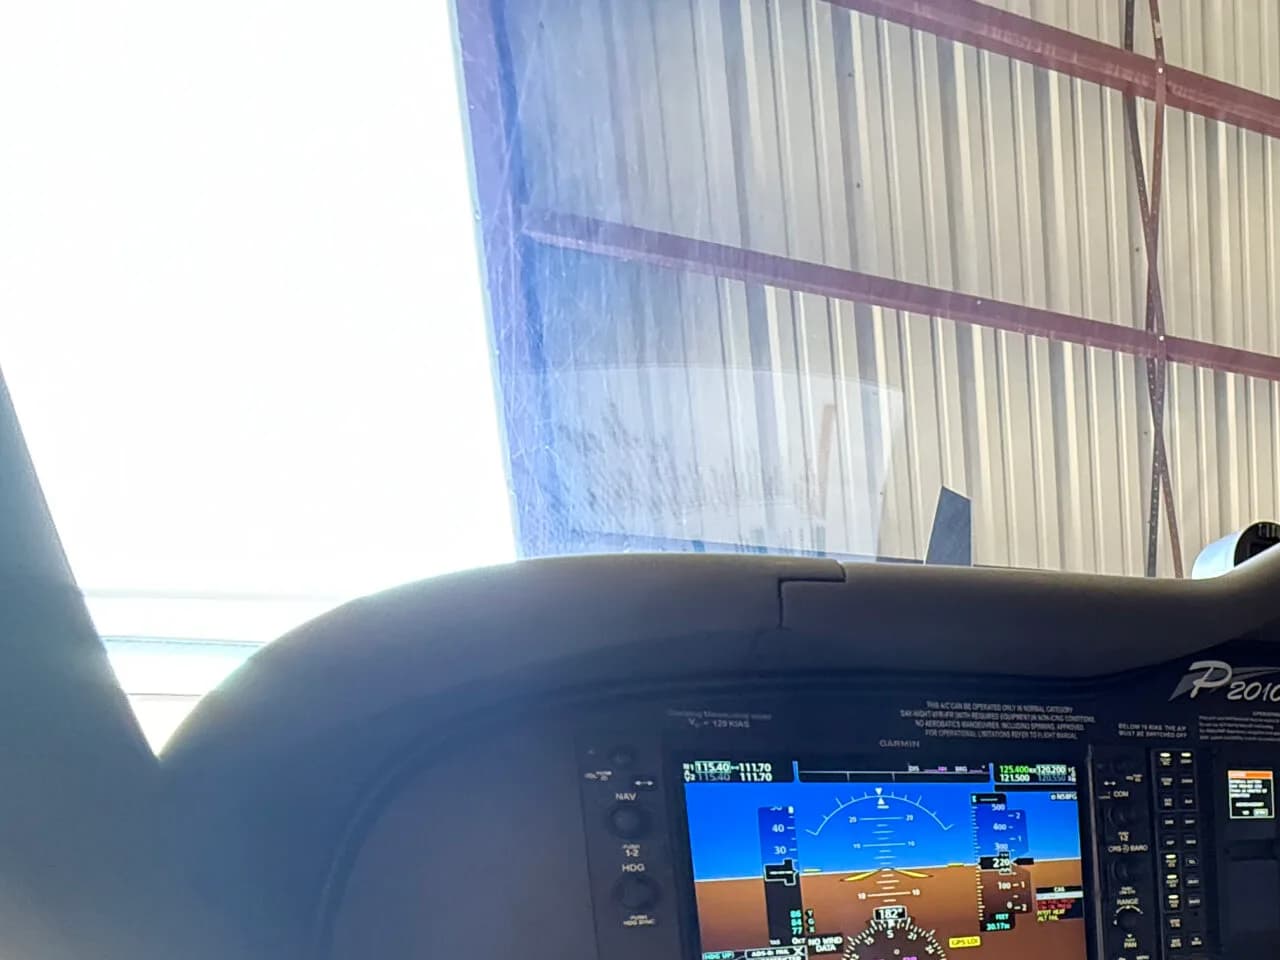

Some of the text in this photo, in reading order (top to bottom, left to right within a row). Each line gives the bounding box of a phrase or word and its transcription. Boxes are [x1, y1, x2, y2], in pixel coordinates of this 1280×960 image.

[739, 762, 772, 772] 111.70
[740, 772, 773, 782] 111.70
[1000, 773, 1030, 782] 121.500
[615, 792, 637, 801] NAV
[1113, 790, 1129, 798] COM
[772, 823, 785, 832] 40
[993, 823, 1007, 831] 400
[774, 846, 787, 855] 30
[622, 863, 645, 872] HDG
[998, 881, 1012, 890] 100
[887, 930, 894, 938] S
[808, 938, 821, 946] NO
[816, 944, 837, 952] DATA
